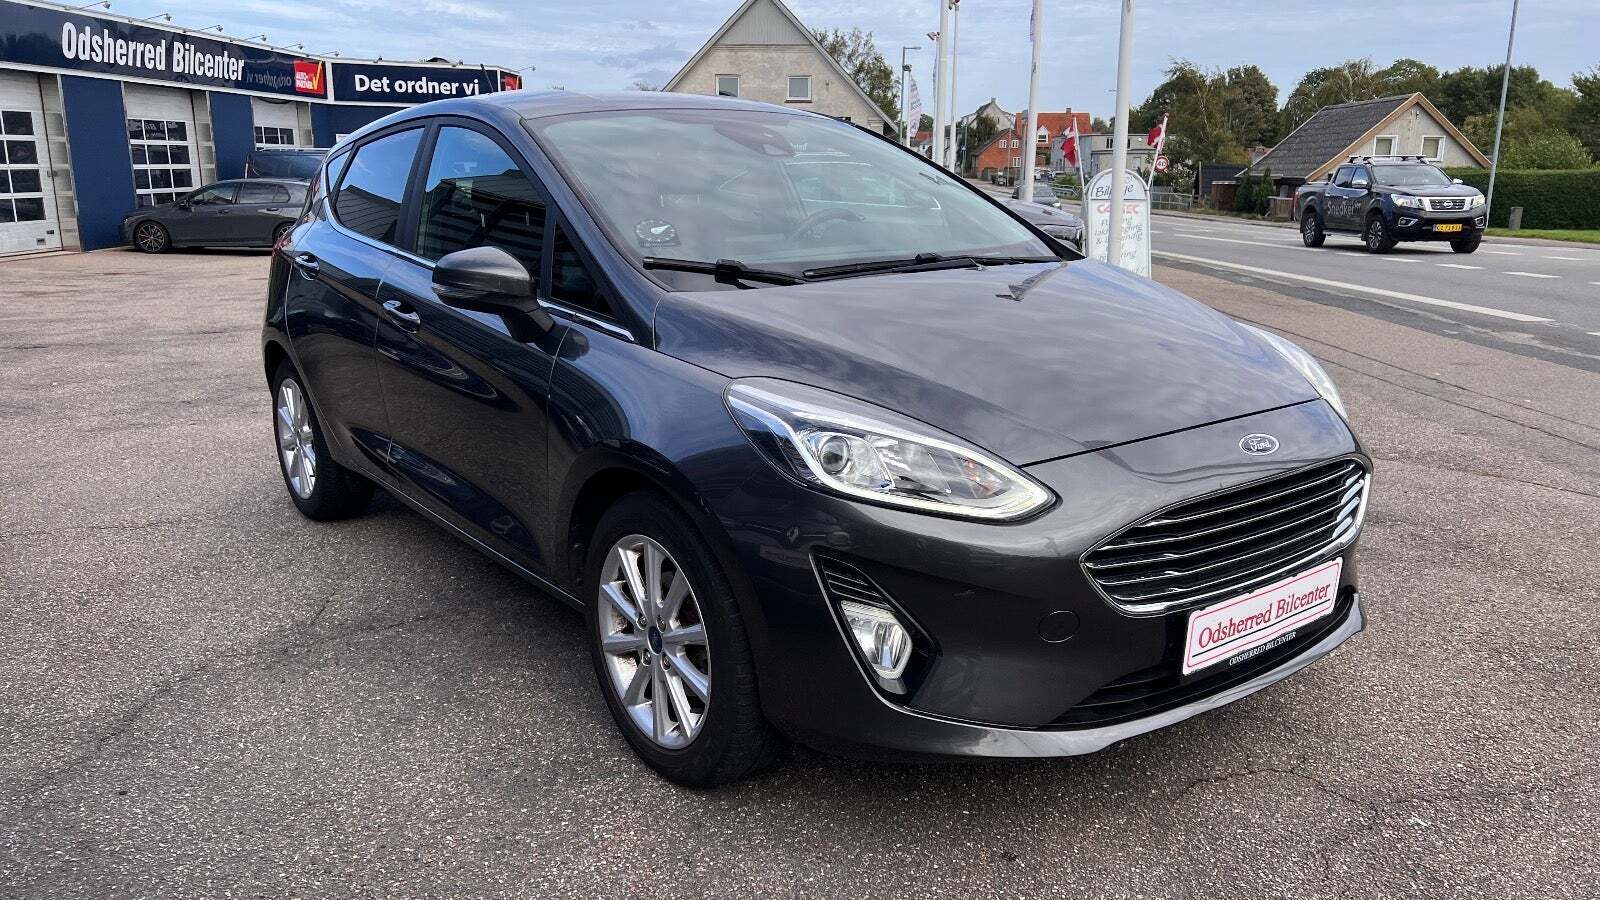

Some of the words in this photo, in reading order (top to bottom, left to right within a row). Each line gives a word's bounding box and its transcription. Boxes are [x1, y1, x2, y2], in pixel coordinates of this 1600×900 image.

[62, 21, 166, 71] Odsherred
[172, 41, 245, 81] Bilcenter
[354, 74, 391, 92] Det
[394, 77, 460, 95] ordner
[462, 79, 480, 96] vi
[1248, 437, 1271, 451] Ford
[1198, 607, 1273, 649] Odsherred
[1275, 583, 1331, 619] Bilcenter
[1229, 645, 1266, 666] ODSHERRED
[1265, 631, 1297, 651] BILCENTER
